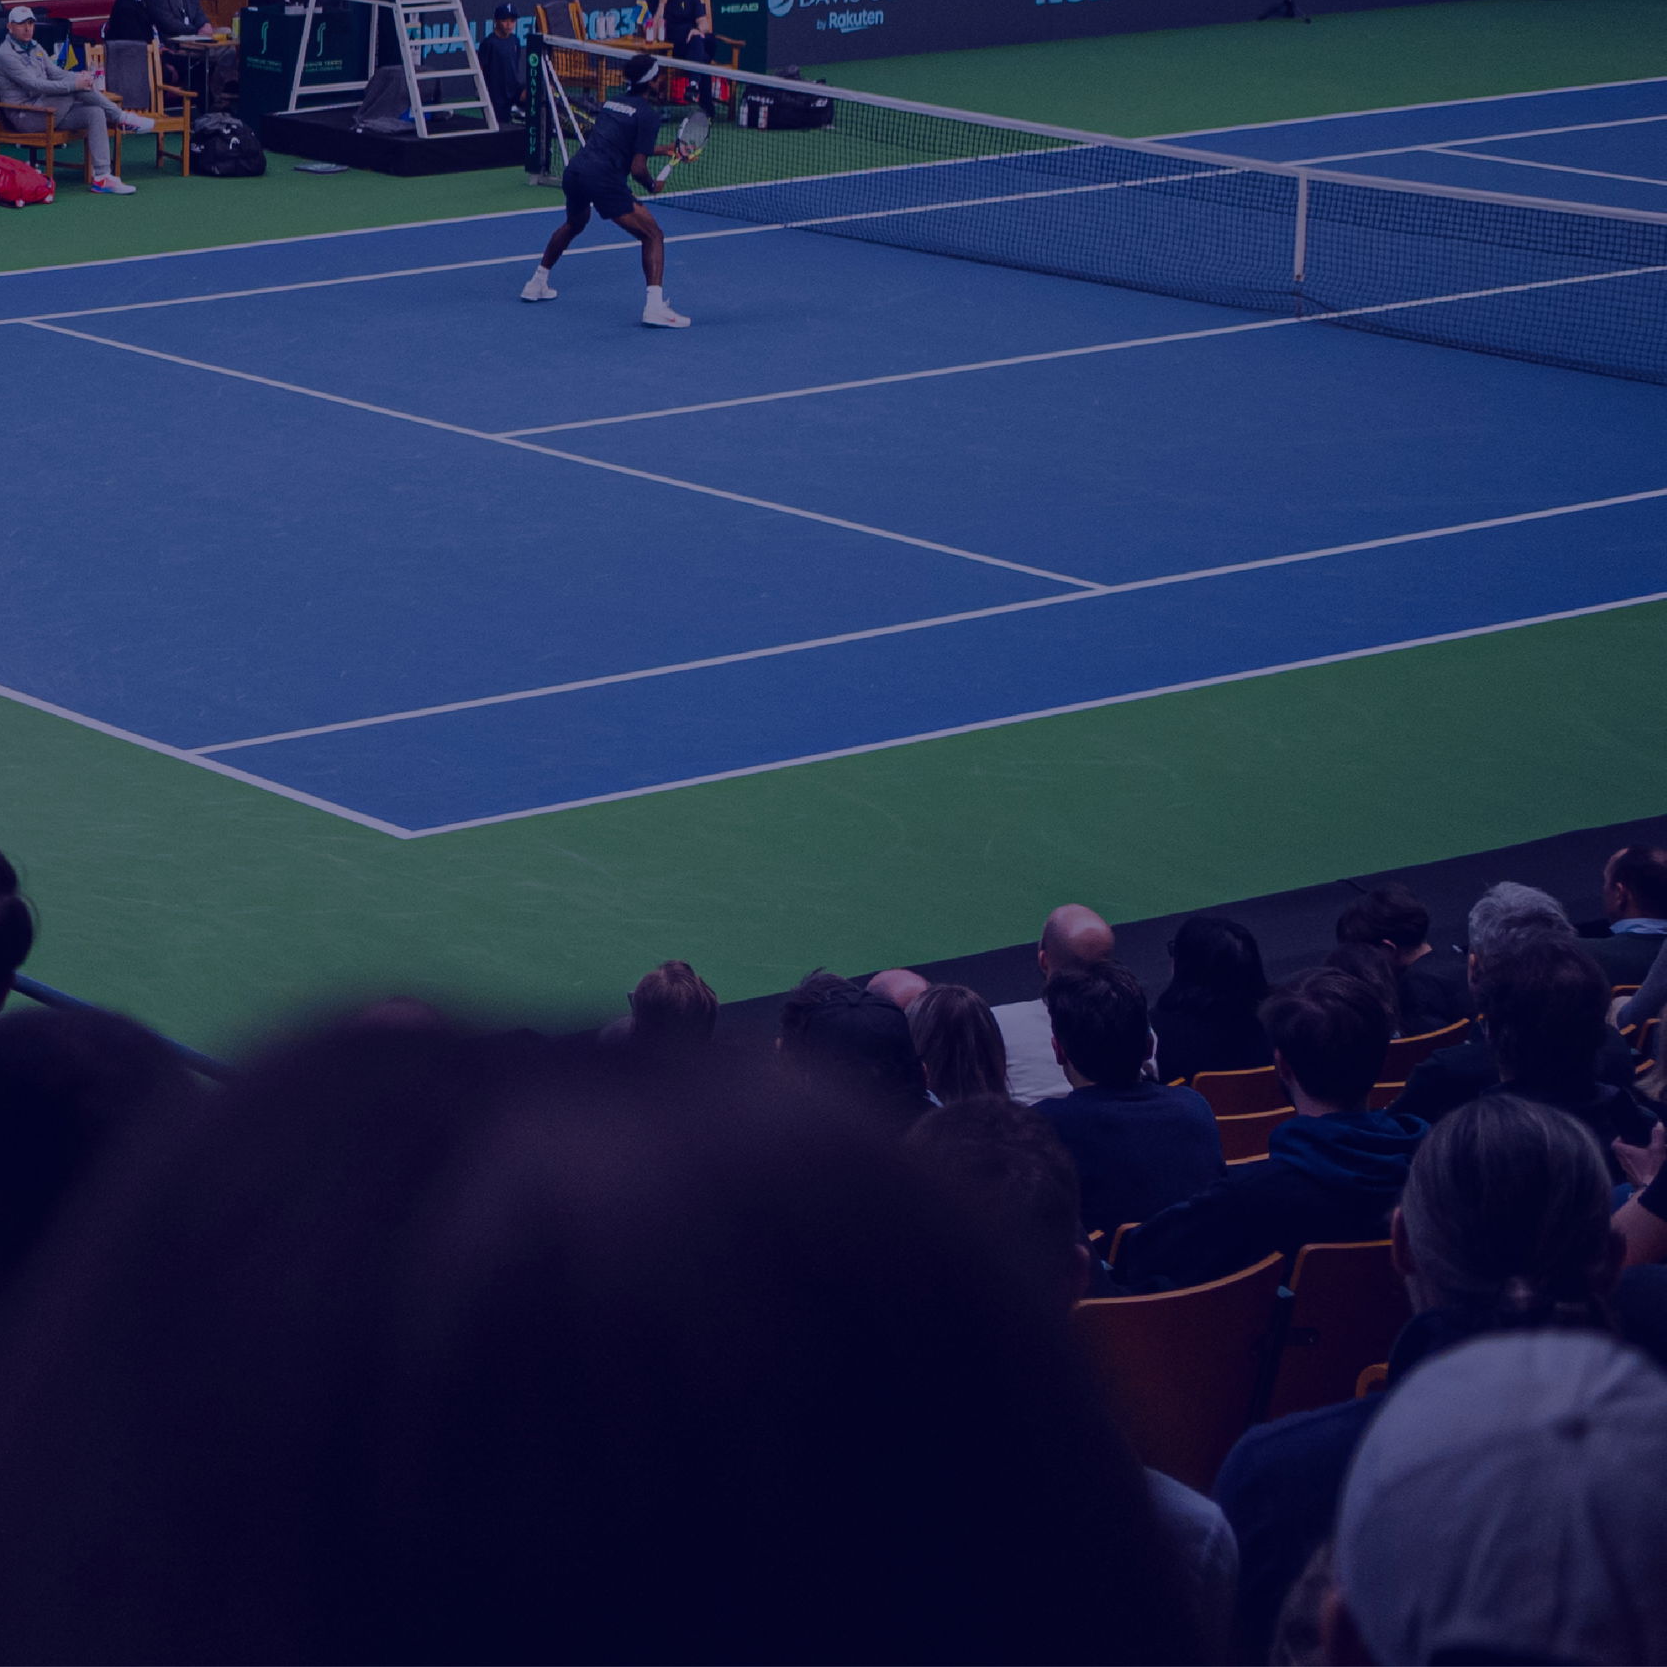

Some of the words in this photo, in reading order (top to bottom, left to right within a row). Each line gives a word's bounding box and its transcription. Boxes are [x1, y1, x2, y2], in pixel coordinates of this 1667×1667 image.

[721, 2, 759, 14] HEAD
[816, 19, 826, 31] by
[829, 10, 884, 32] Rakuten
